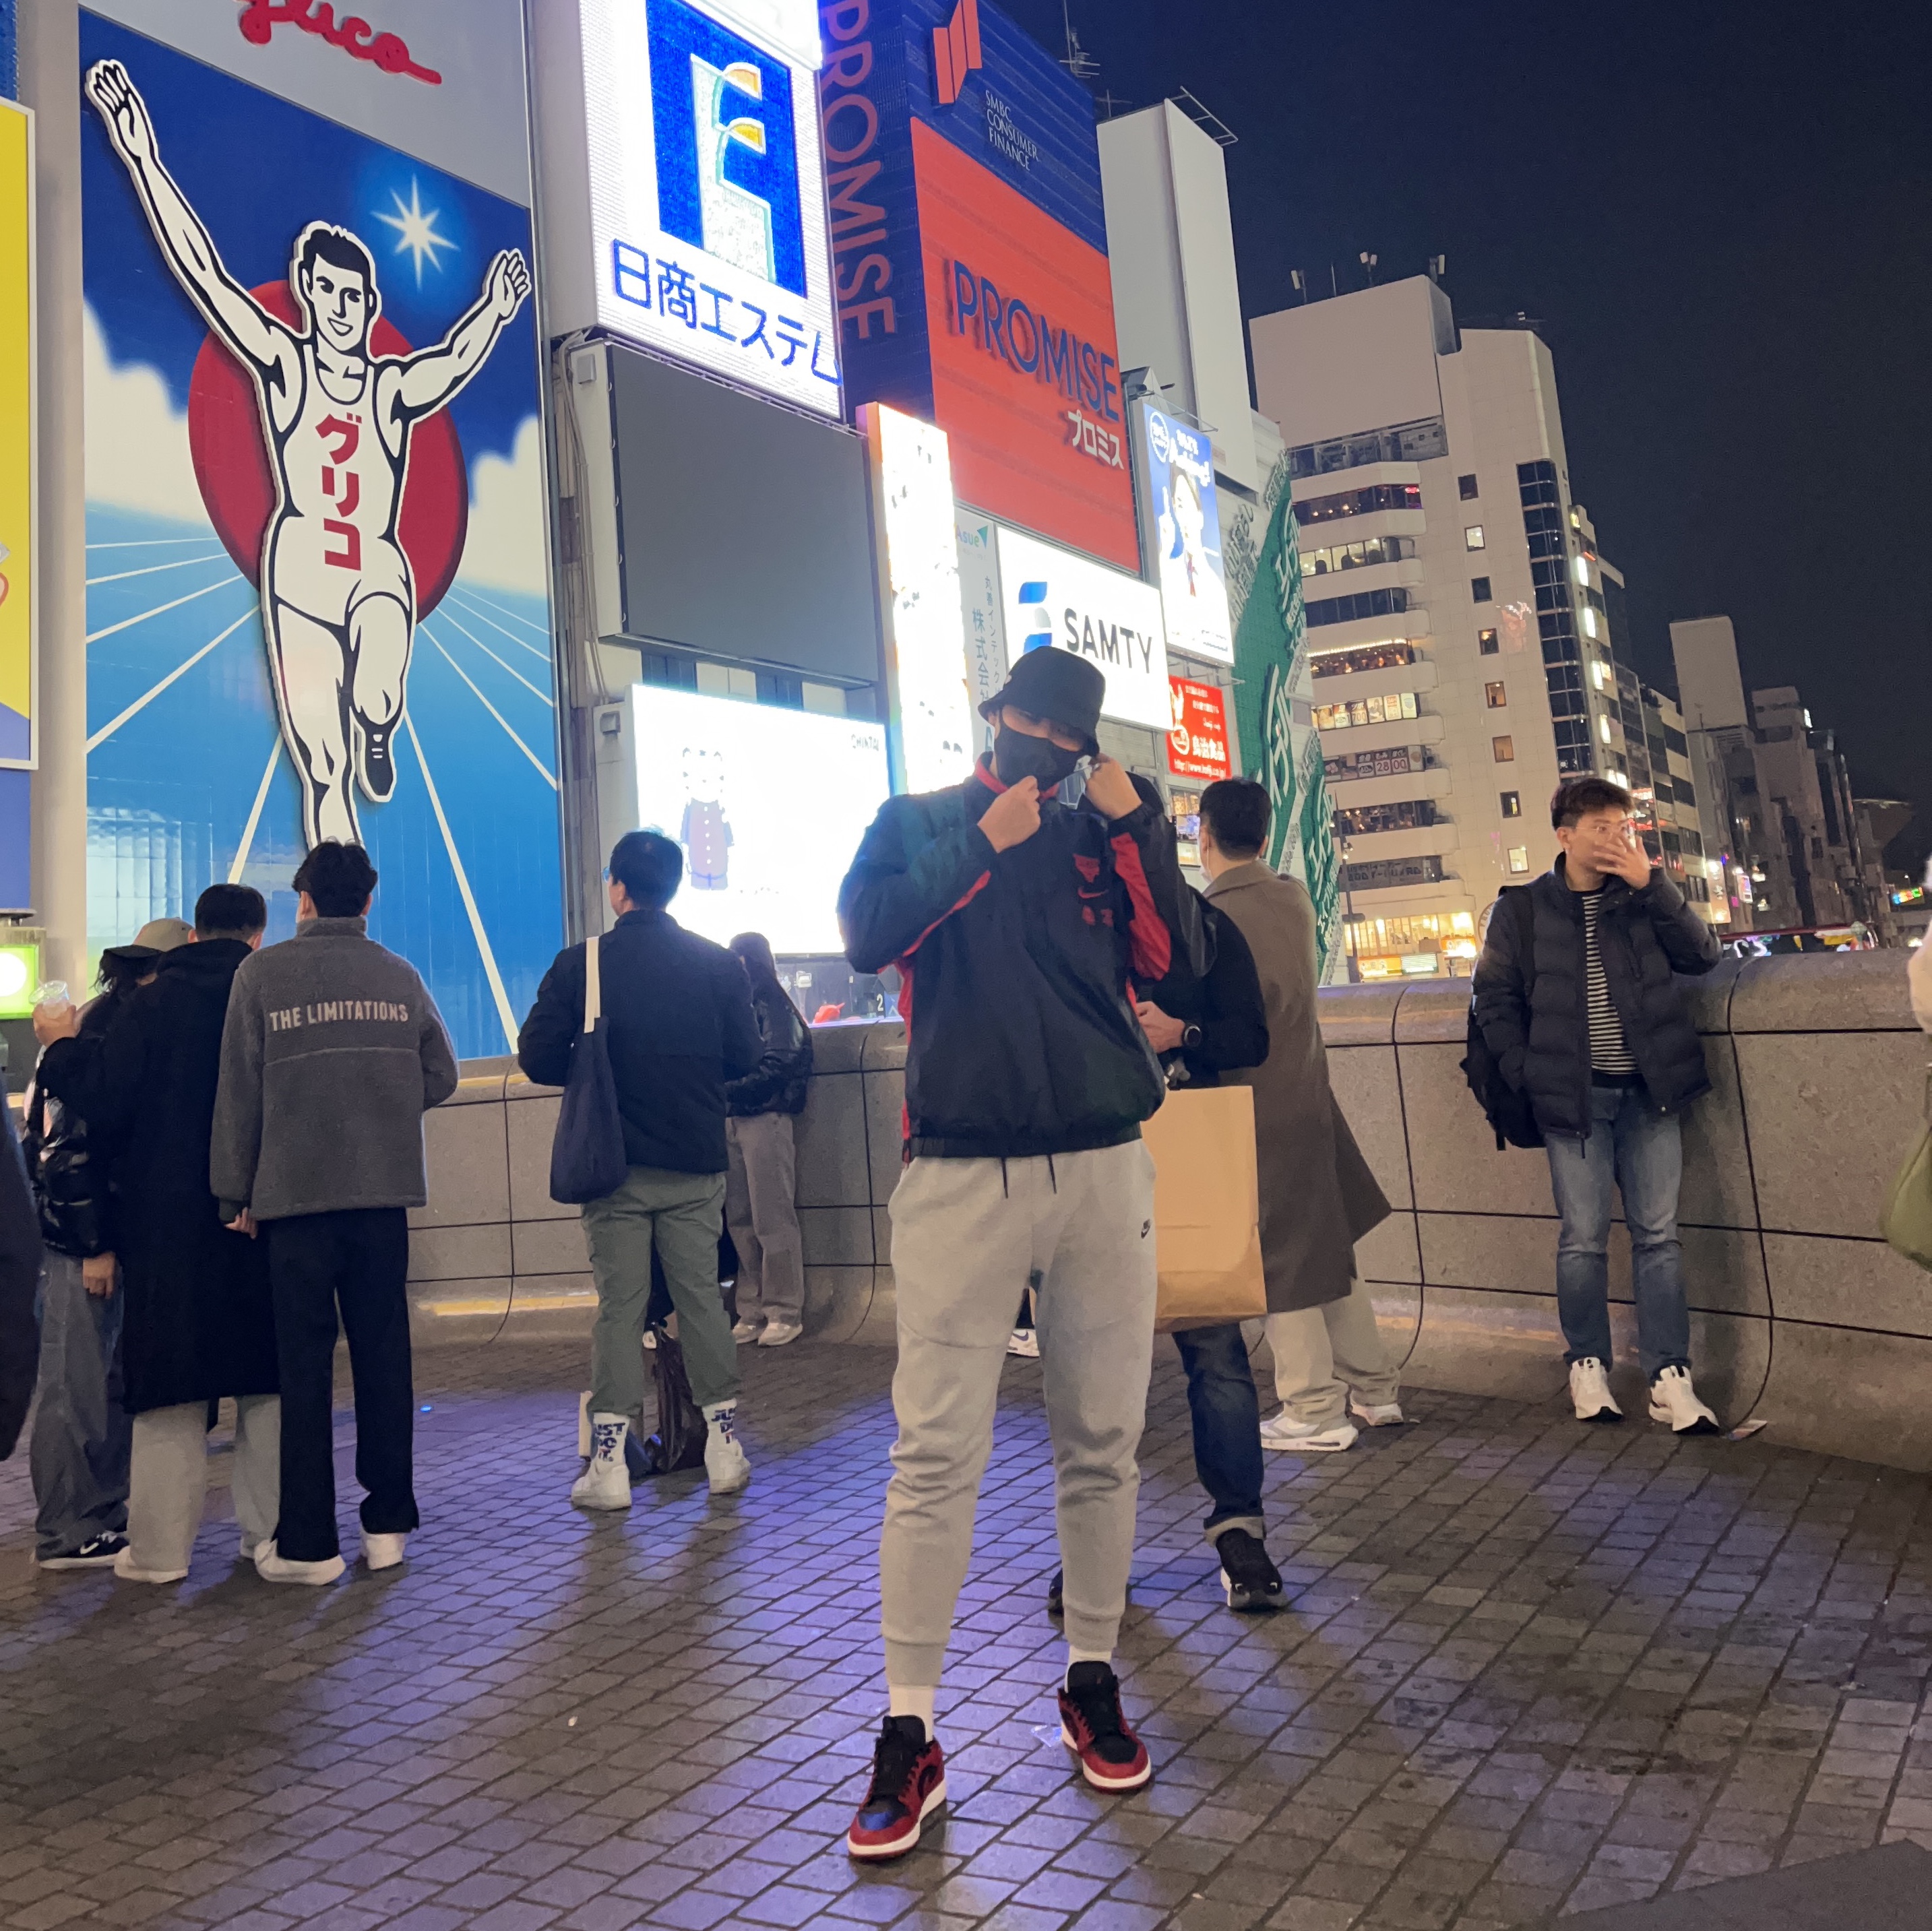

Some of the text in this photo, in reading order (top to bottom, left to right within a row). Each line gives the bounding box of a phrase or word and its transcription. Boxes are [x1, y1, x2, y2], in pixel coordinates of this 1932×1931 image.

[985, 90, 1012, 123] SMBC
[987, 108, 1039, 162] CONSUMER
[818, 0, 896, 345] PROMISE
[989, 126, 1030, 171] FINANCE
[612, 238, 842, 387] 日商エステム
[950, 259, 1119, 423] PROMISE
[1067, 408, 1124, 470] プロミス
[315, 412, 362, 571] グリコ
[1063, 607, 1153, 674] SAMTY
[270, 1000, 409, 1032] THE LIMITATIONS
[876, 993, 884, 1012] 2
